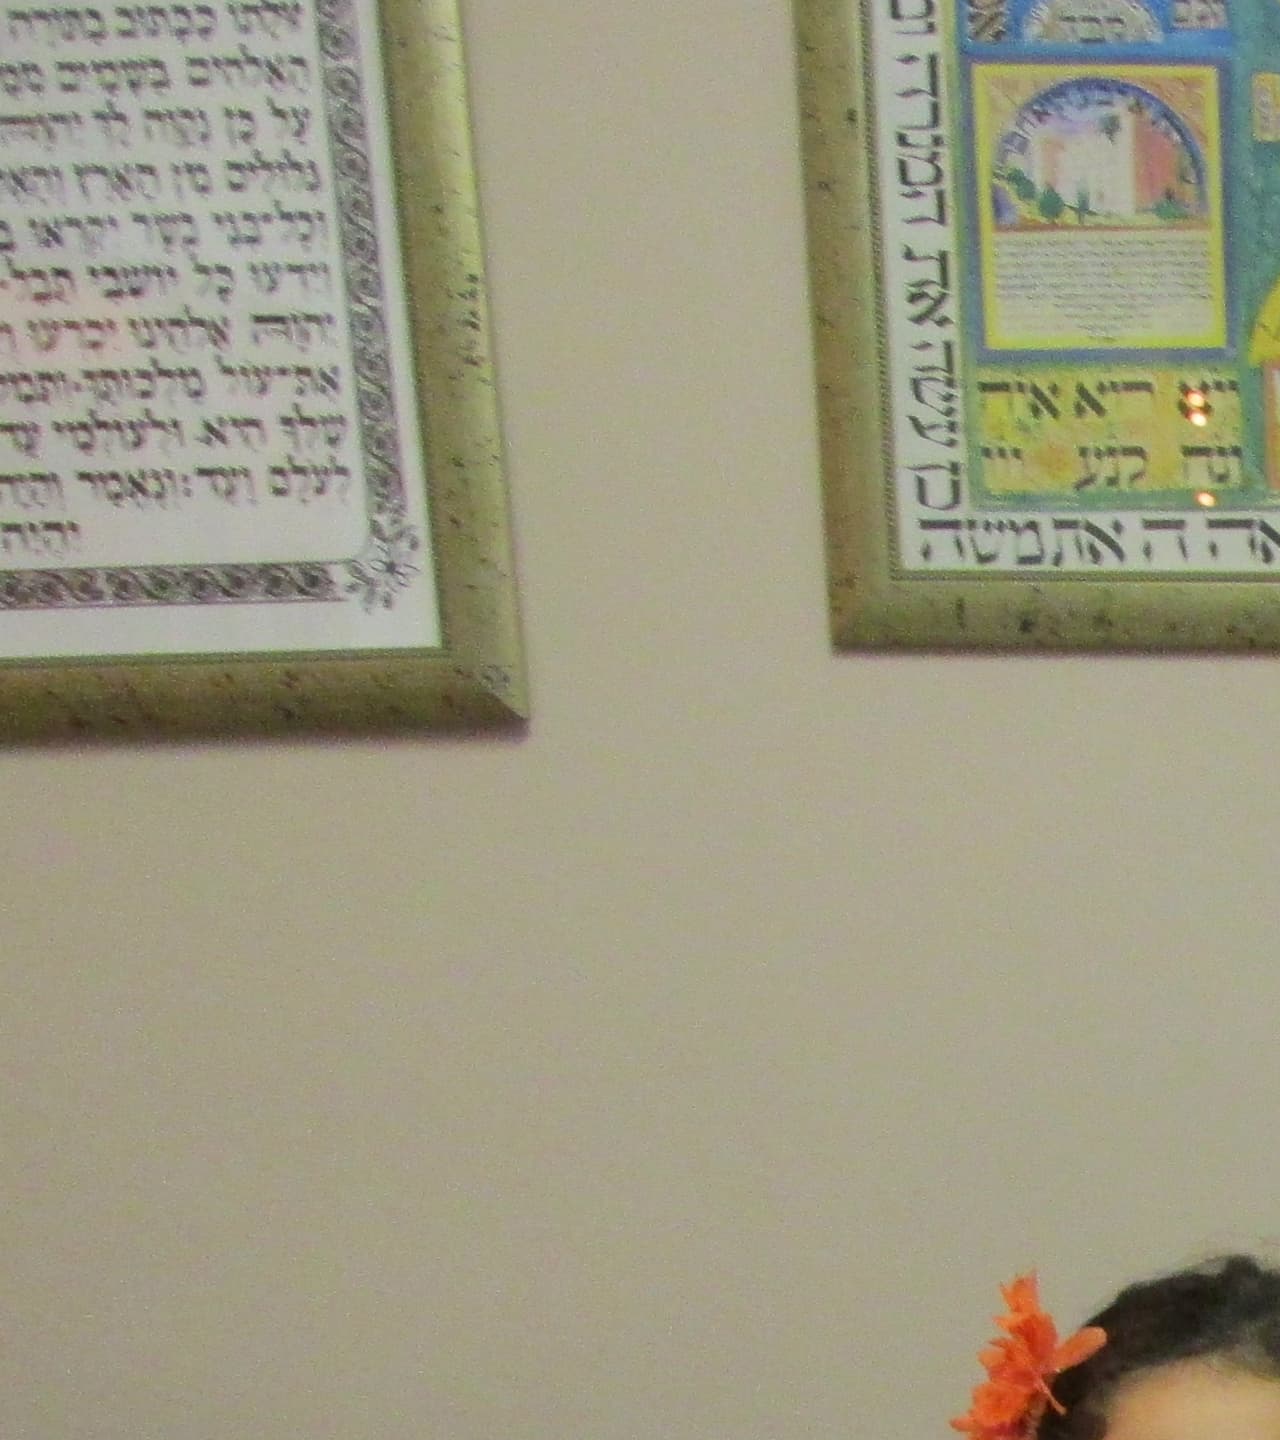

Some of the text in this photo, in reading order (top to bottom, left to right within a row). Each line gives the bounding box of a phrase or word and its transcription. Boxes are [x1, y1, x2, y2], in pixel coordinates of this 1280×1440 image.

[895, 52, 948, 227] המנרה
[902, 243, 955, 327] את
[906, 340, 958, 449] עשה
[905, 461, 960, 511] כן
[917, 517, 1043, 565] משה
[1051, 517, 1126, 568] את
